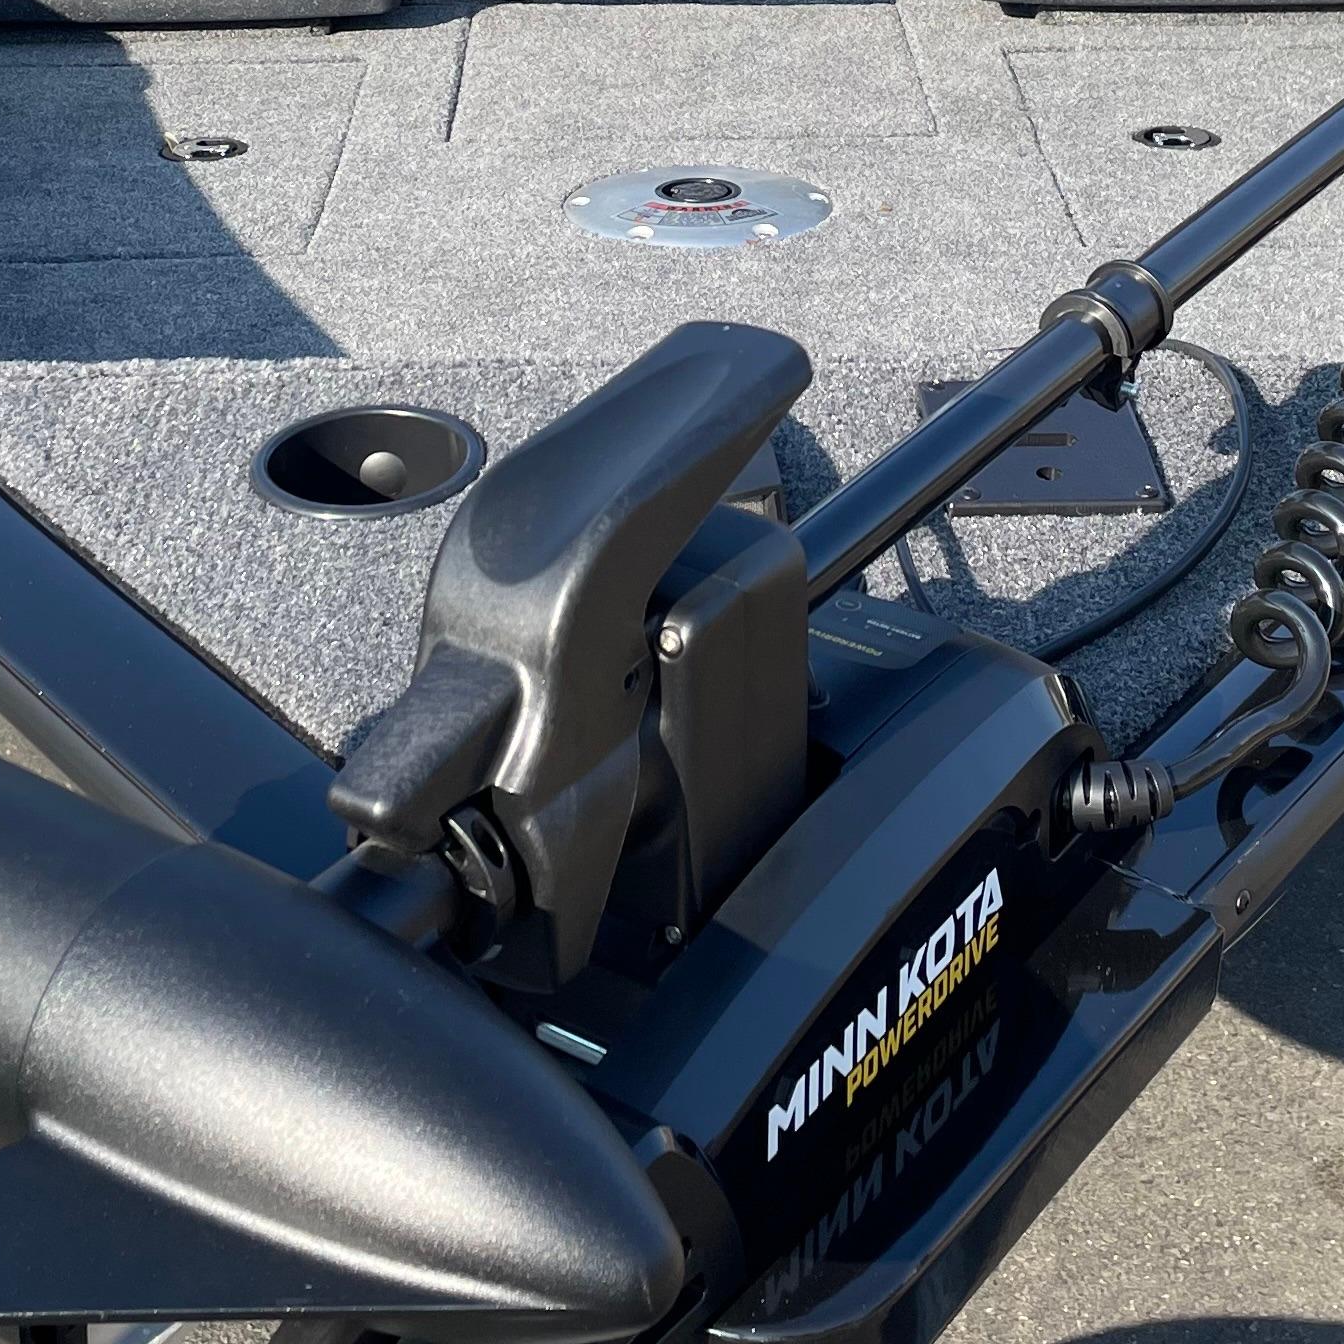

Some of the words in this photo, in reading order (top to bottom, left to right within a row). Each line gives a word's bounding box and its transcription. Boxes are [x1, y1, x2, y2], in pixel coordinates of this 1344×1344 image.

[767, 985, 890, 1162] MINN
[899, 867, 1004, 1016] KOTA
[845, 912, 1000, 1107] POWERDRIVE
